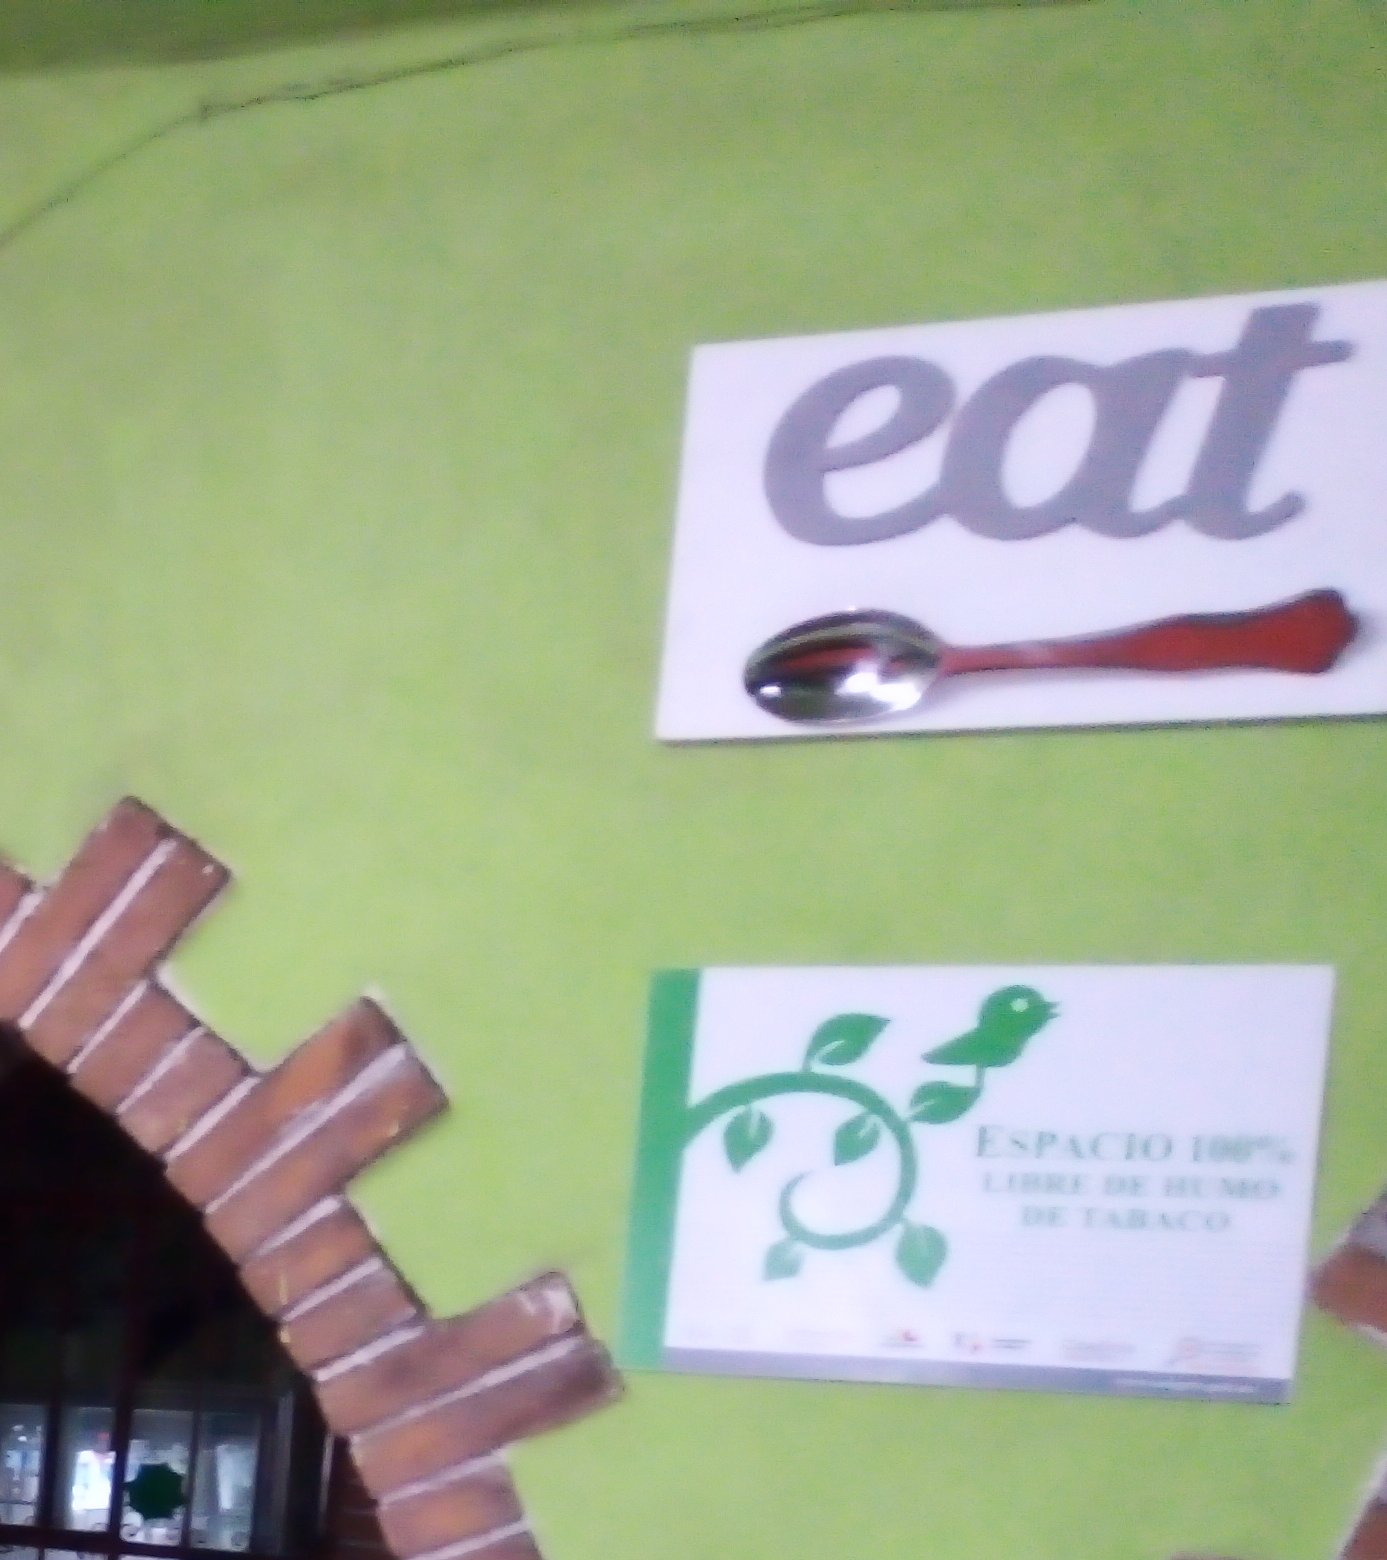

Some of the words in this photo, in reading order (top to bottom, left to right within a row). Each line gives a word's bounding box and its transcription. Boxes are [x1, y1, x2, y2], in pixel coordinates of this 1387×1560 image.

[764, 303, 1354, 547] eat
[976, 1124, 1173, 1162] ESPACIO
[983, 1171, 1089, 1195] LIBRE
[1104, 1173, 1150, 1197] DE
[1021, 1205, 1067, 1229] DE
[1081, 1206, 1231, 1233] TABACO
